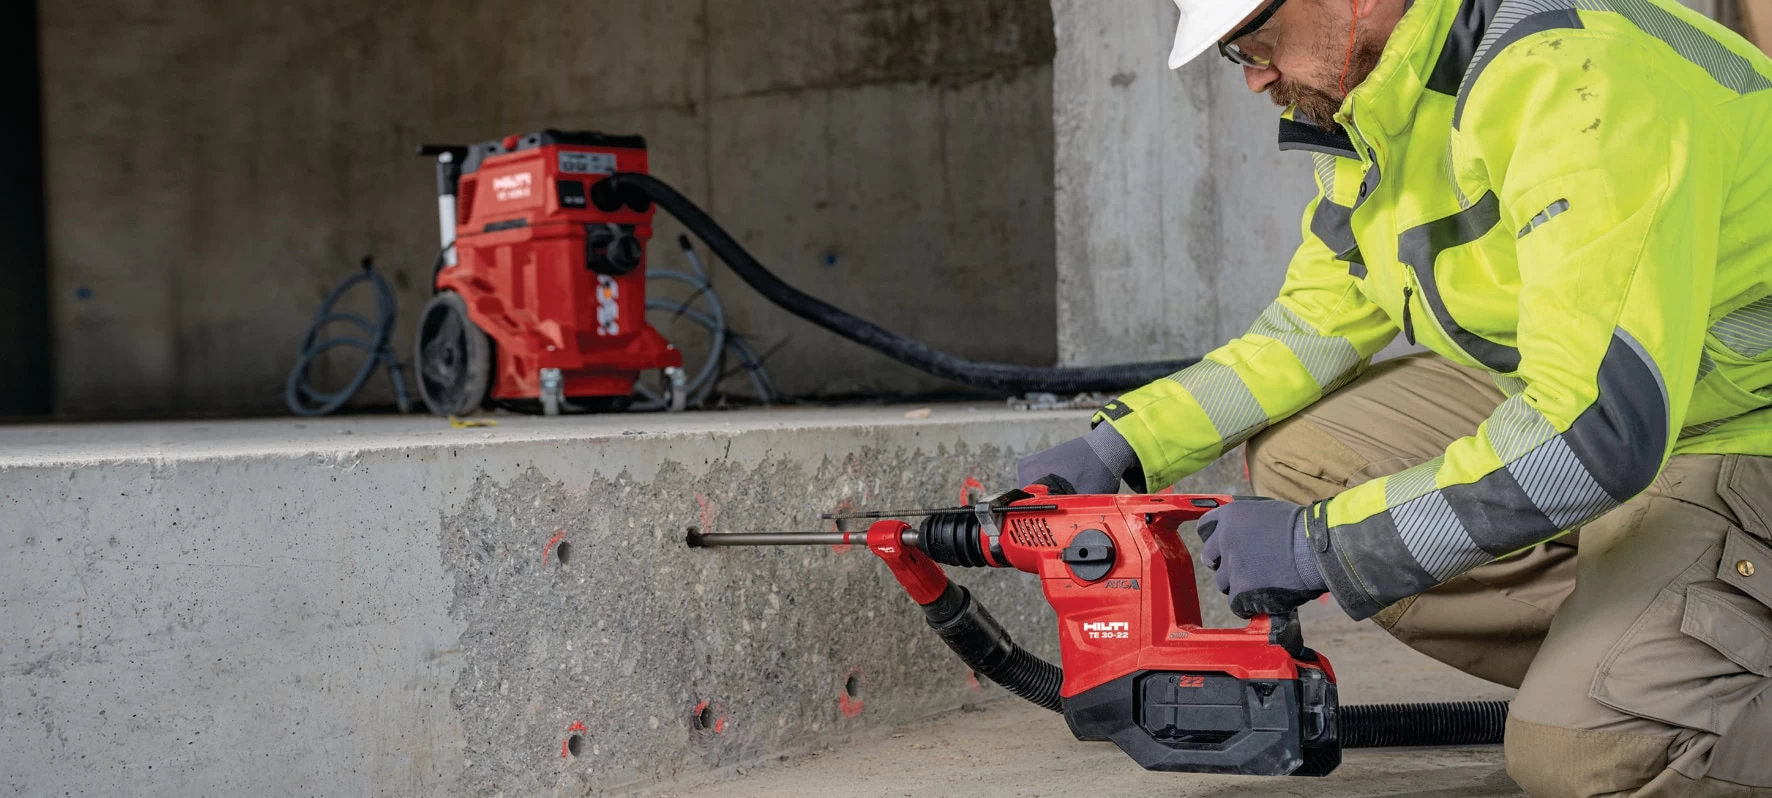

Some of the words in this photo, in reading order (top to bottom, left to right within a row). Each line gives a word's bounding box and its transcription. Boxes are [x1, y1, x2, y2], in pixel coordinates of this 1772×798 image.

[492, 172, 532, 191] HILTI
[1083, 621, 1129, 631] HILTI
[1088, 631, 1100, 639] TE
[1101, 631, 1129, 639] 30-22
[1179, 674, 1205, 688] 22
